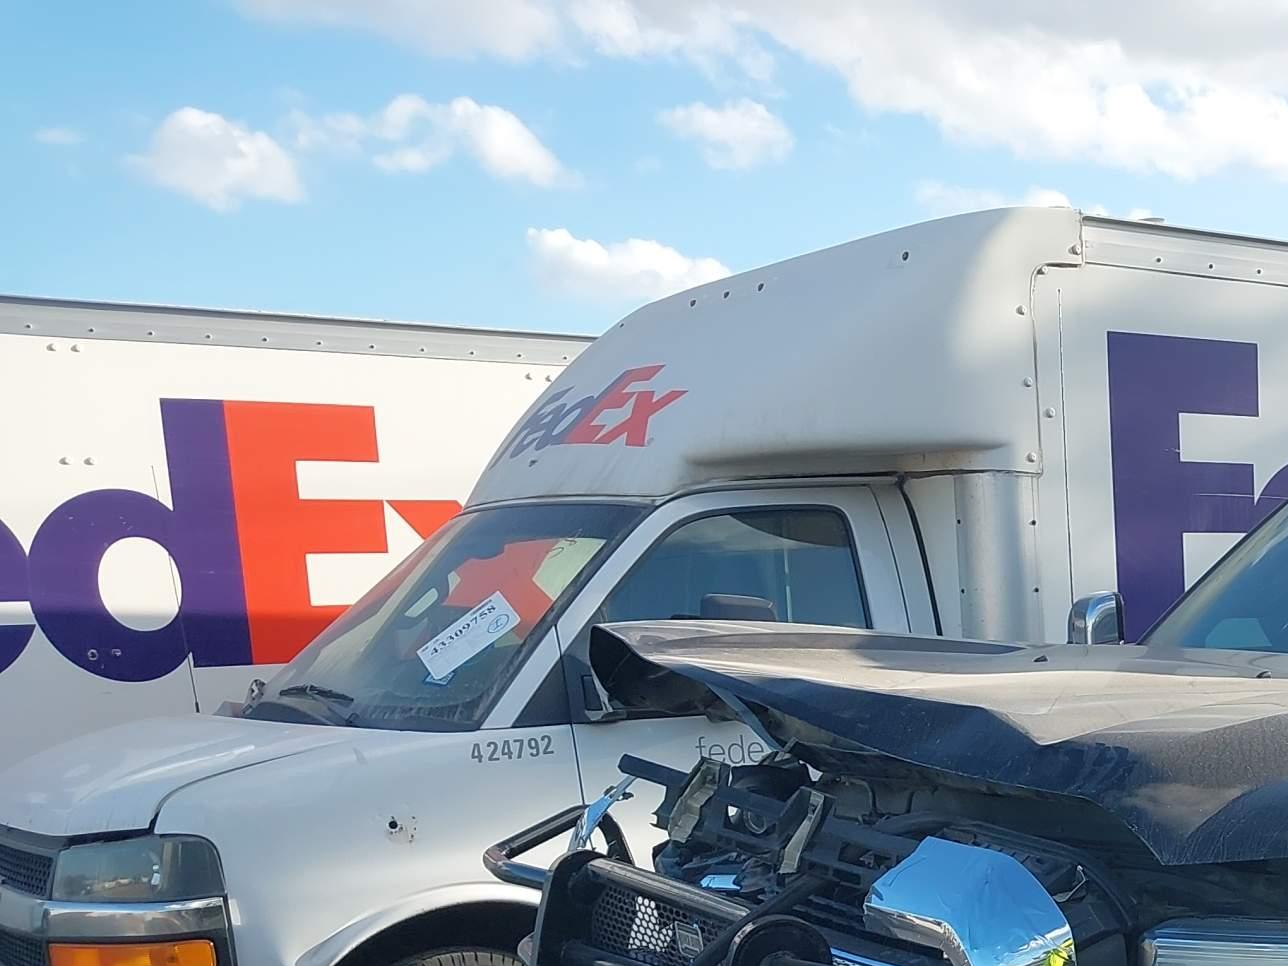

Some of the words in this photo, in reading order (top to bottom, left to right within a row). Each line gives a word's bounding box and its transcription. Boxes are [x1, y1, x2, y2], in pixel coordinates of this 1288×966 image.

[488, 364, 689, 472] FedEx
[431, 604, 496, 656] 43309758
[471, 735, 554, 763] 424792
